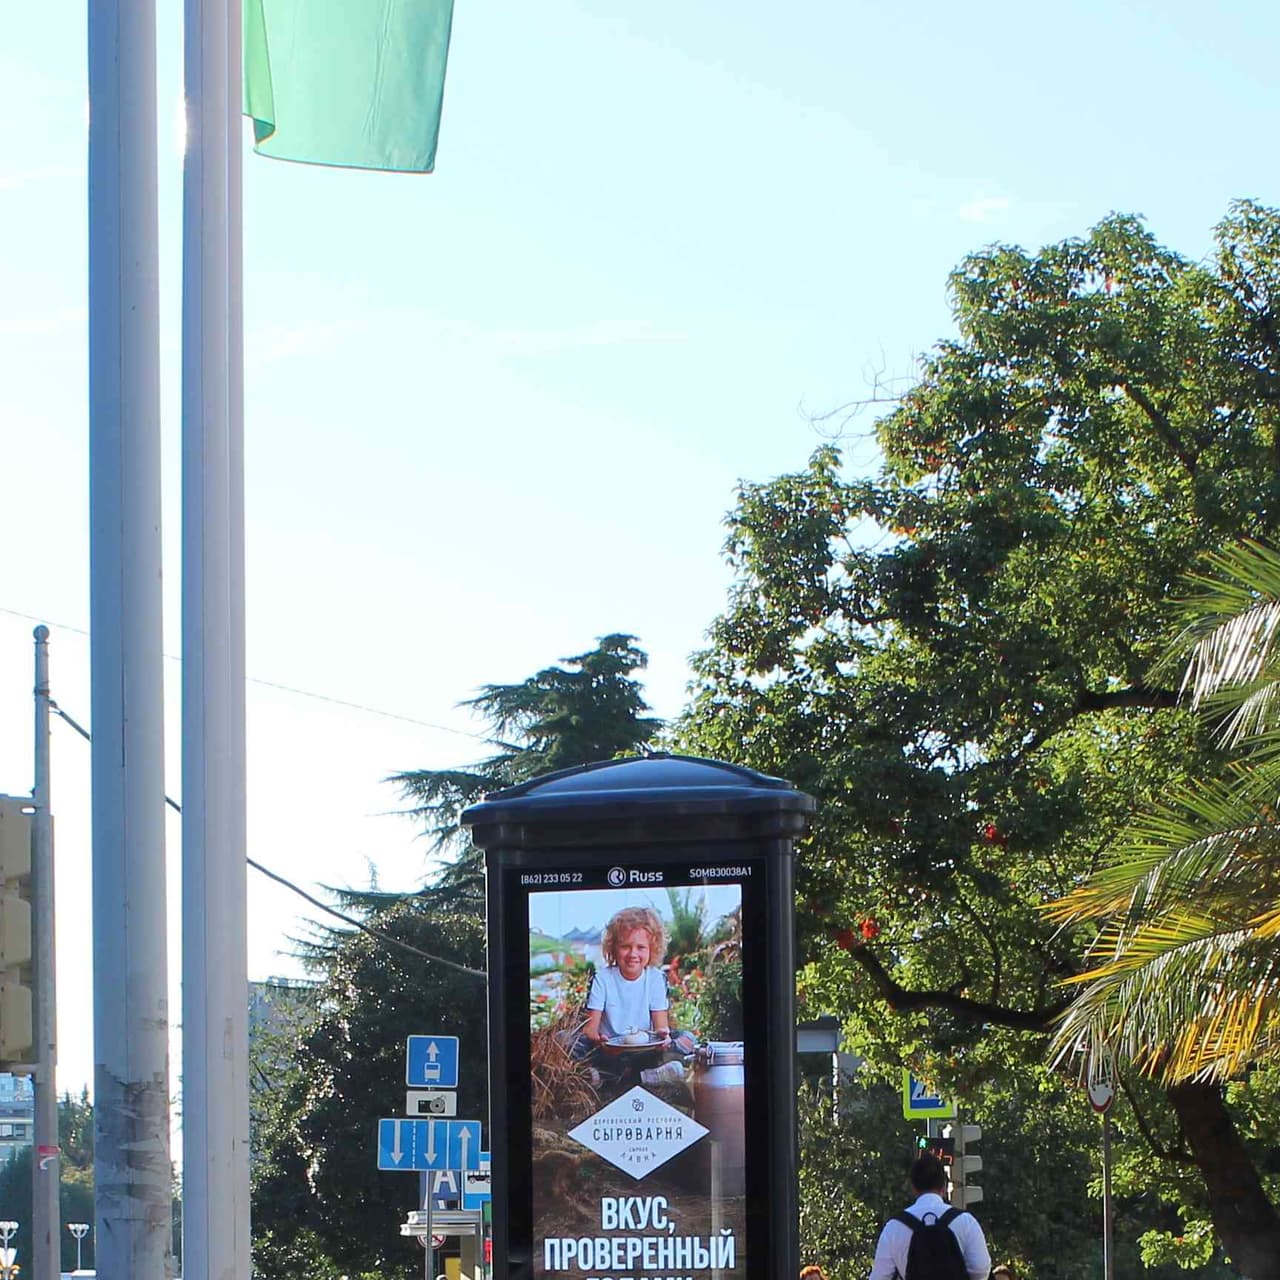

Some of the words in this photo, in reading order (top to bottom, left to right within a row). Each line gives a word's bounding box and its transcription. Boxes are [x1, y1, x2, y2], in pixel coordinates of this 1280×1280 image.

[521, 873, 542, 885] (862)
[543, 873, 559, 883] 233
[560, 872, 571, 882] 05
[572, 872, 583, 882] 22
[629, 869, 664, 883] Russ
[593, 1127, 683, 1141] СЫРОВАРНЯ
[602, 1196, 675, 1234] ВКУС,
[544, 1229, 735, 1270] ПРОВЕРЕННЫЙ
